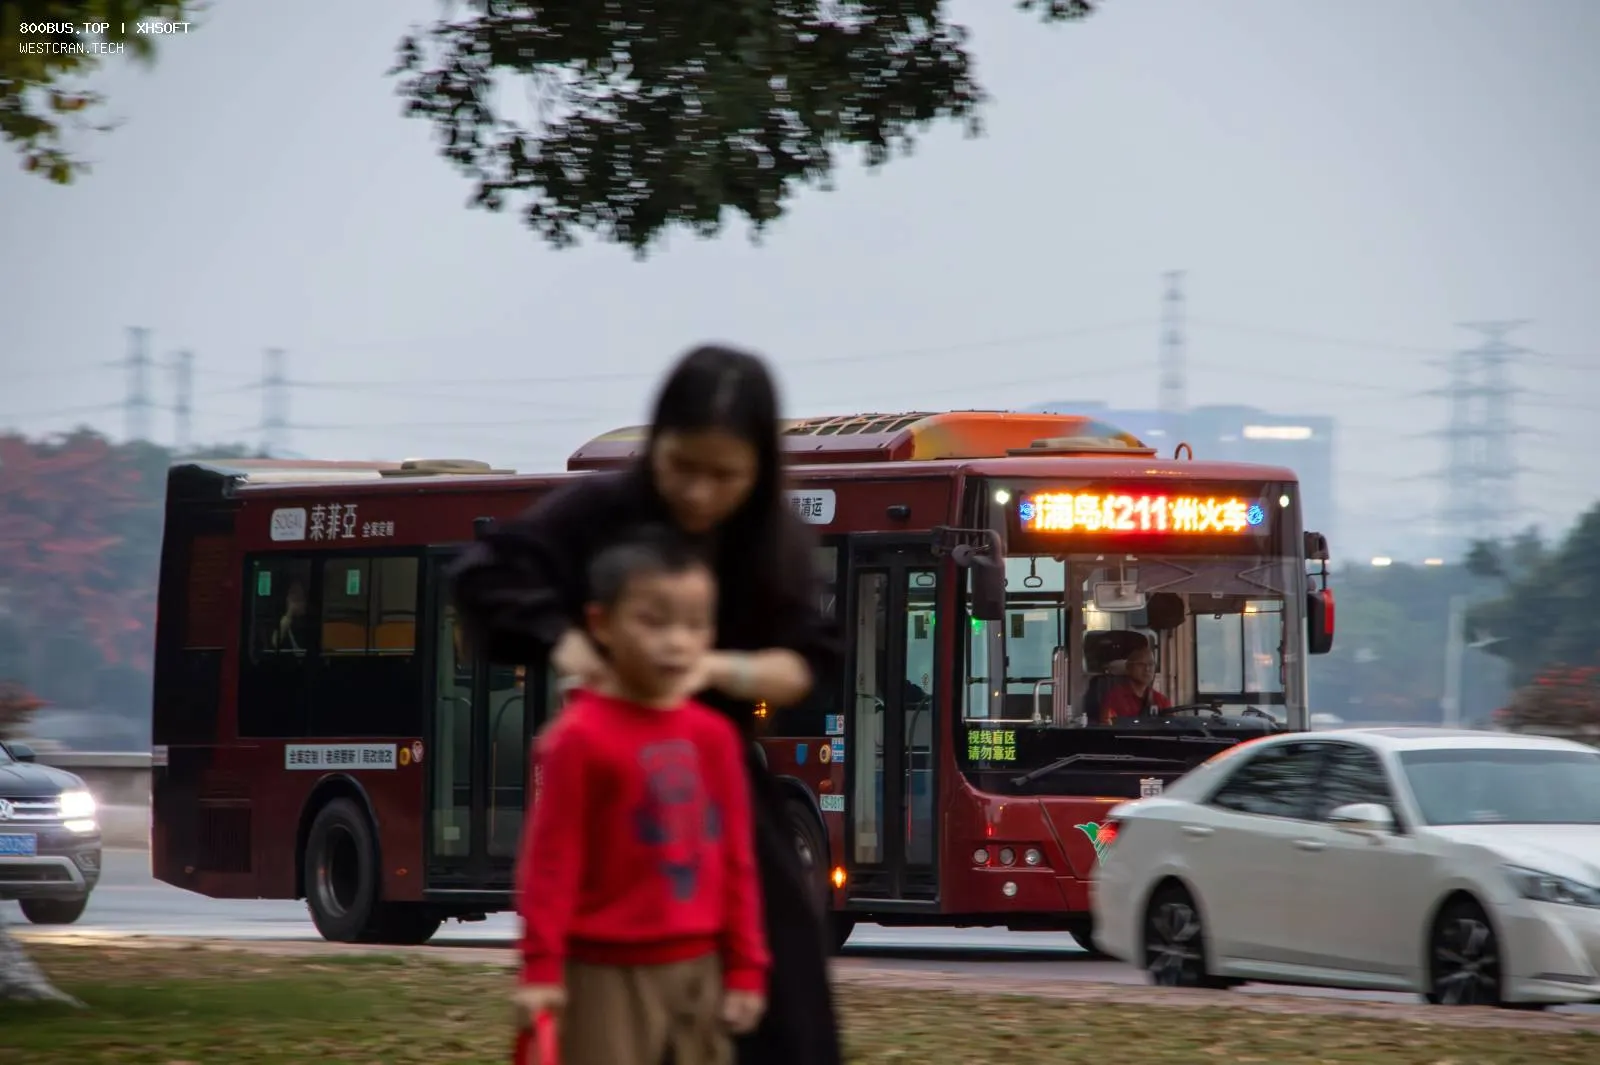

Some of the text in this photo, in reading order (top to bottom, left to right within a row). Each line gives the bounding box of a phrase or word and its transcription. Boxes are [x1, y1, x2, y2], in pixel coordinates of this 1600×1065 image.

[1113, 495, 1167, 530] 211
[968, 729, 1016, 745] 视线盲区
[968, 745, 1017, 760] 请勿靠近
